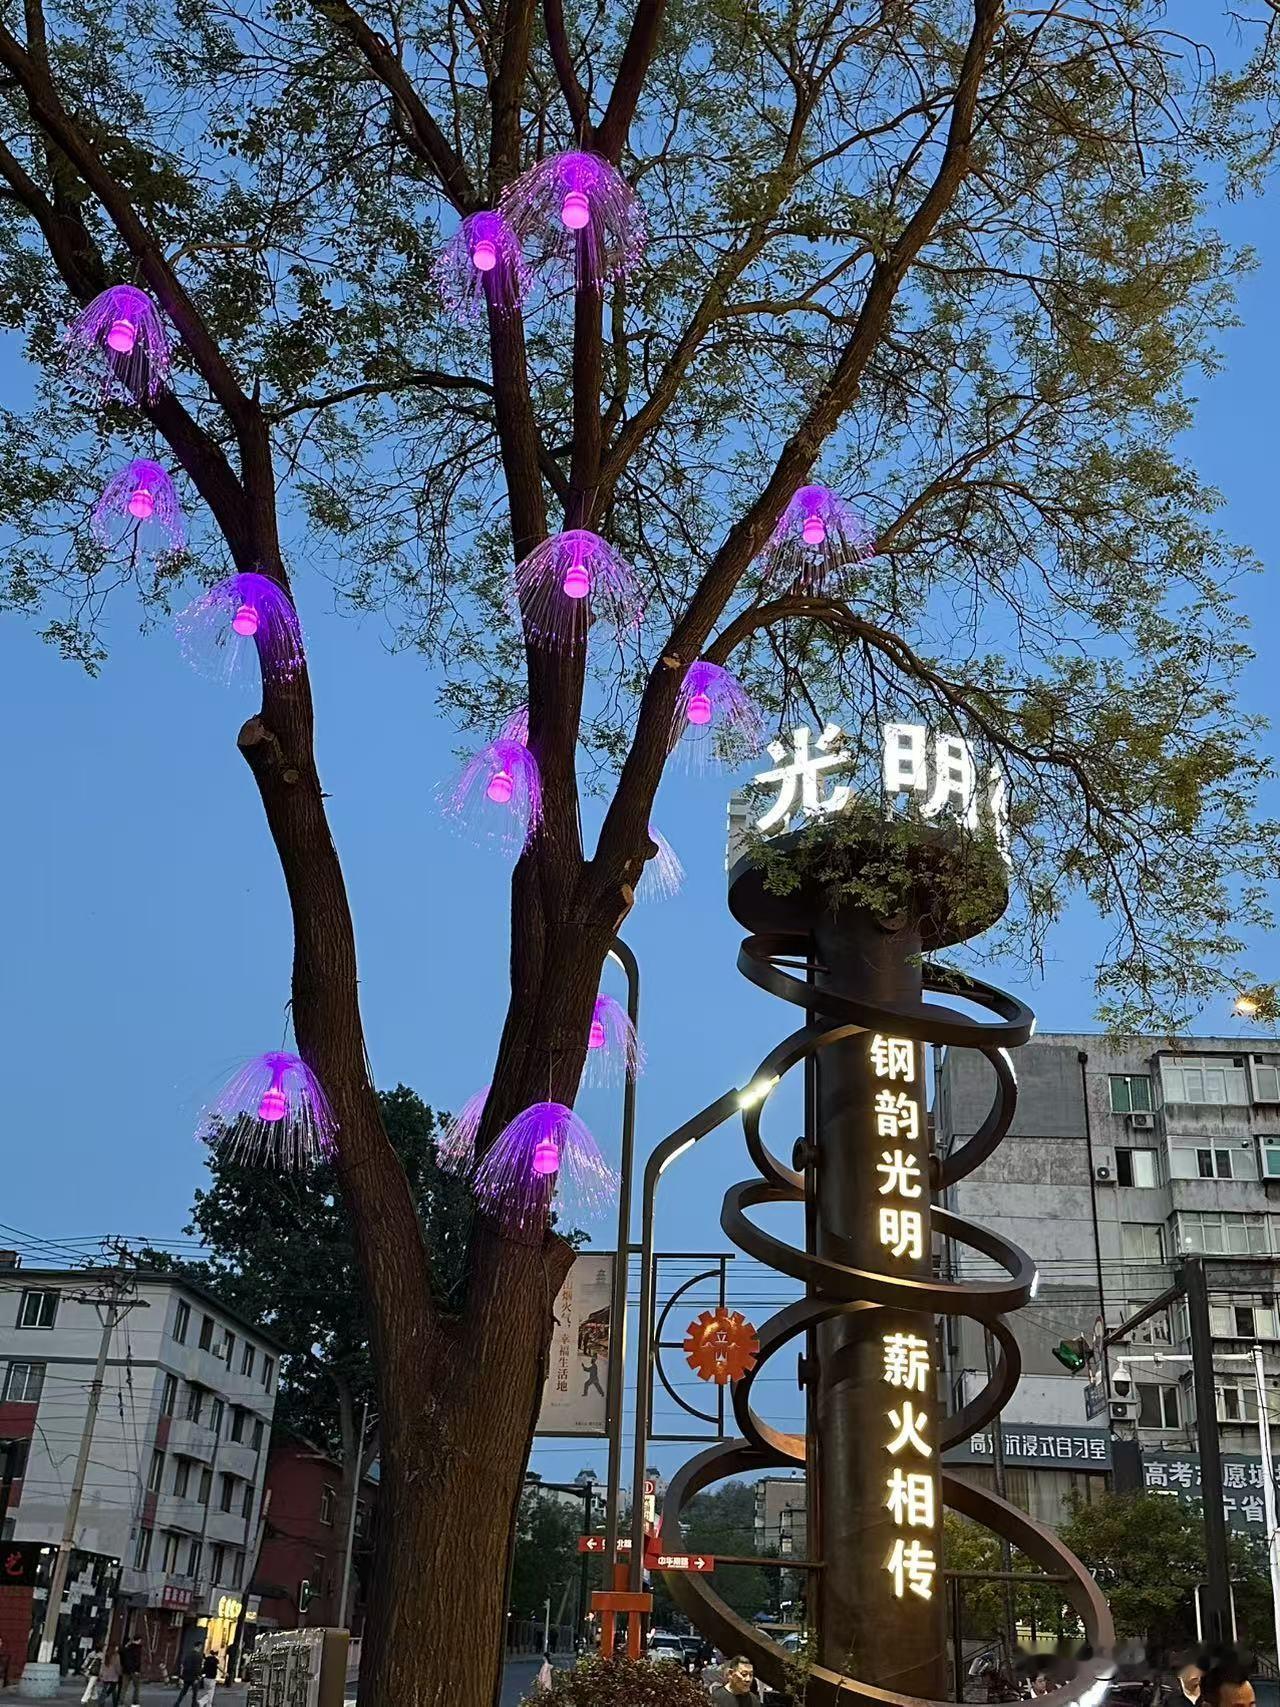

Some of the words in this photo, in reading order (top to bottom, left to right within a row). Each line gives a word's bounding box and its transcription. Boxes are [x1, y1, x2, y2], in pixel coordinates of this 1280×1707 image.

[755, 723, 1011, 868] 光明
[870, 1034, 923, 1260] 钢韵光明
[882, 1333, 936, 1600] 薪火相传
[1143, 1461, 1280, 1489] 高考愿填
